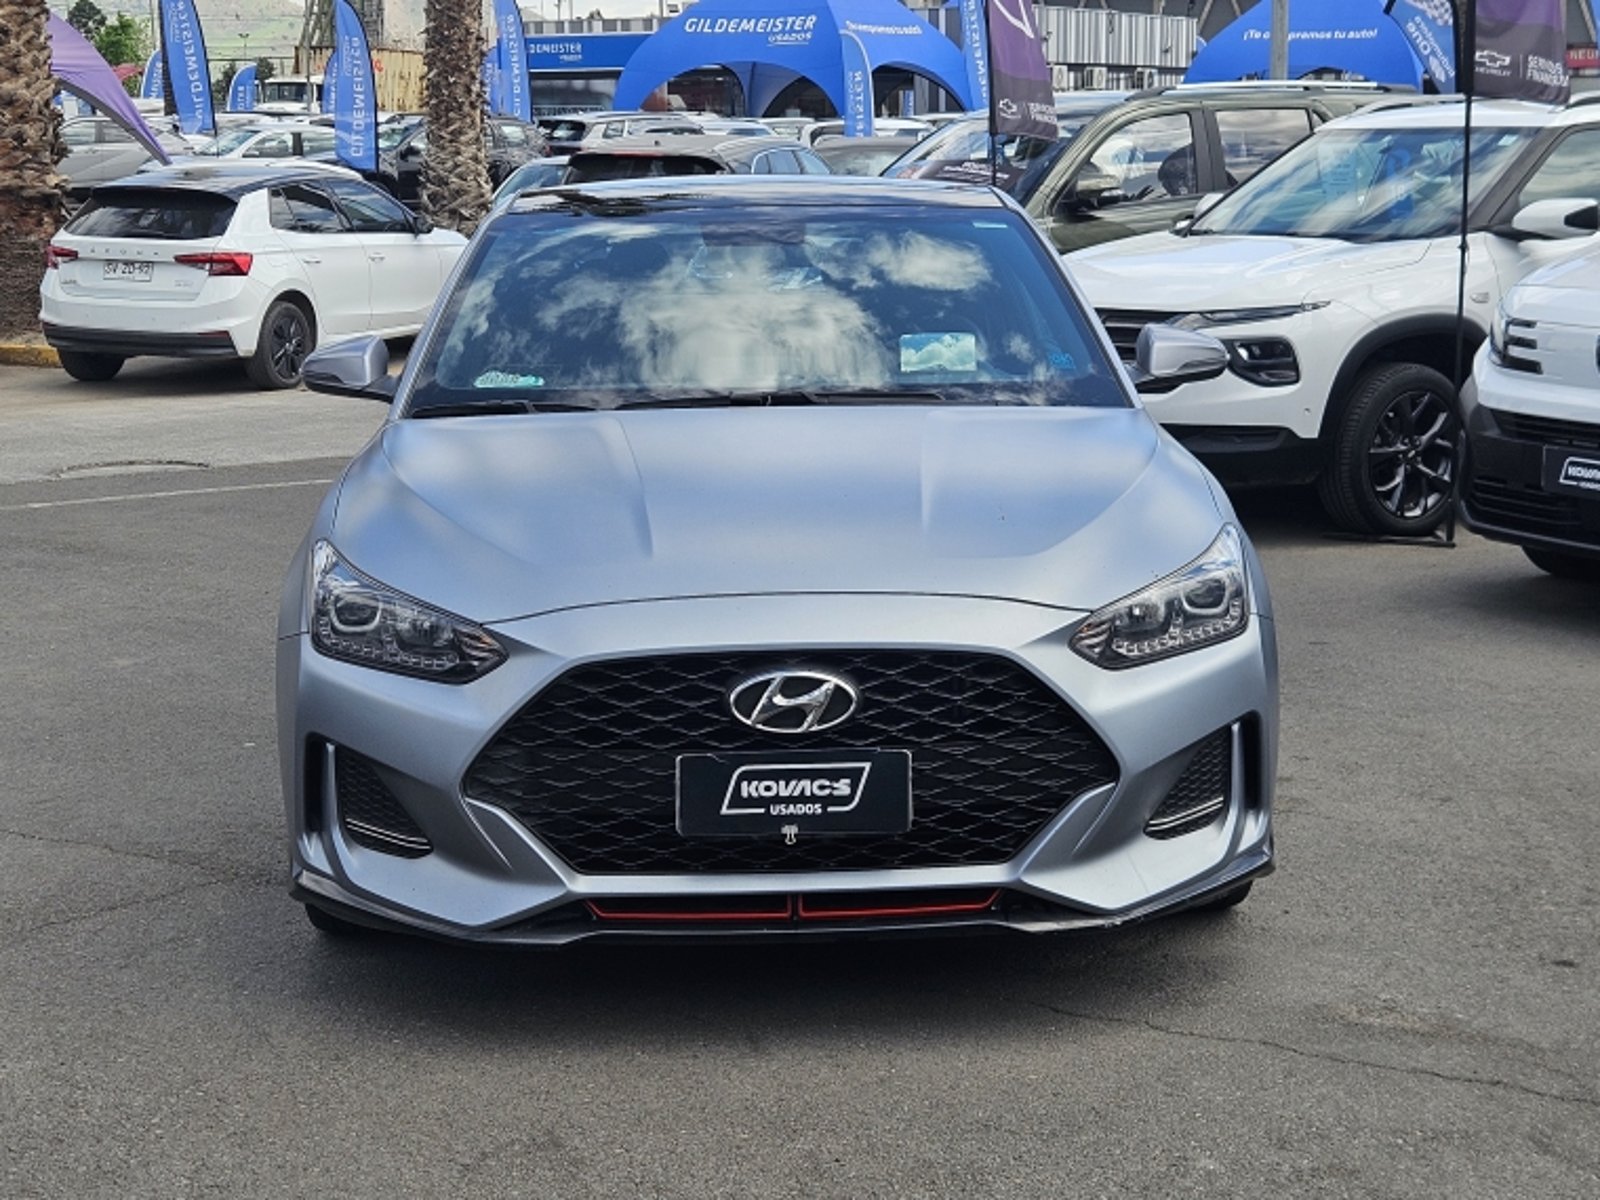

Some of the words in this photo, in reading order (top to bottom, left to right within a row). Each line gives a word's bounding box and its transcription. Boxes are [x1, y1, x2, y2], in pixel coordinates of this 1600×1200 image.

[684, 15, 817, 33] GILDEMEISTER
[741, 779, 851, 798] KOVACS
[769, 804, 822, 815] USADOS
